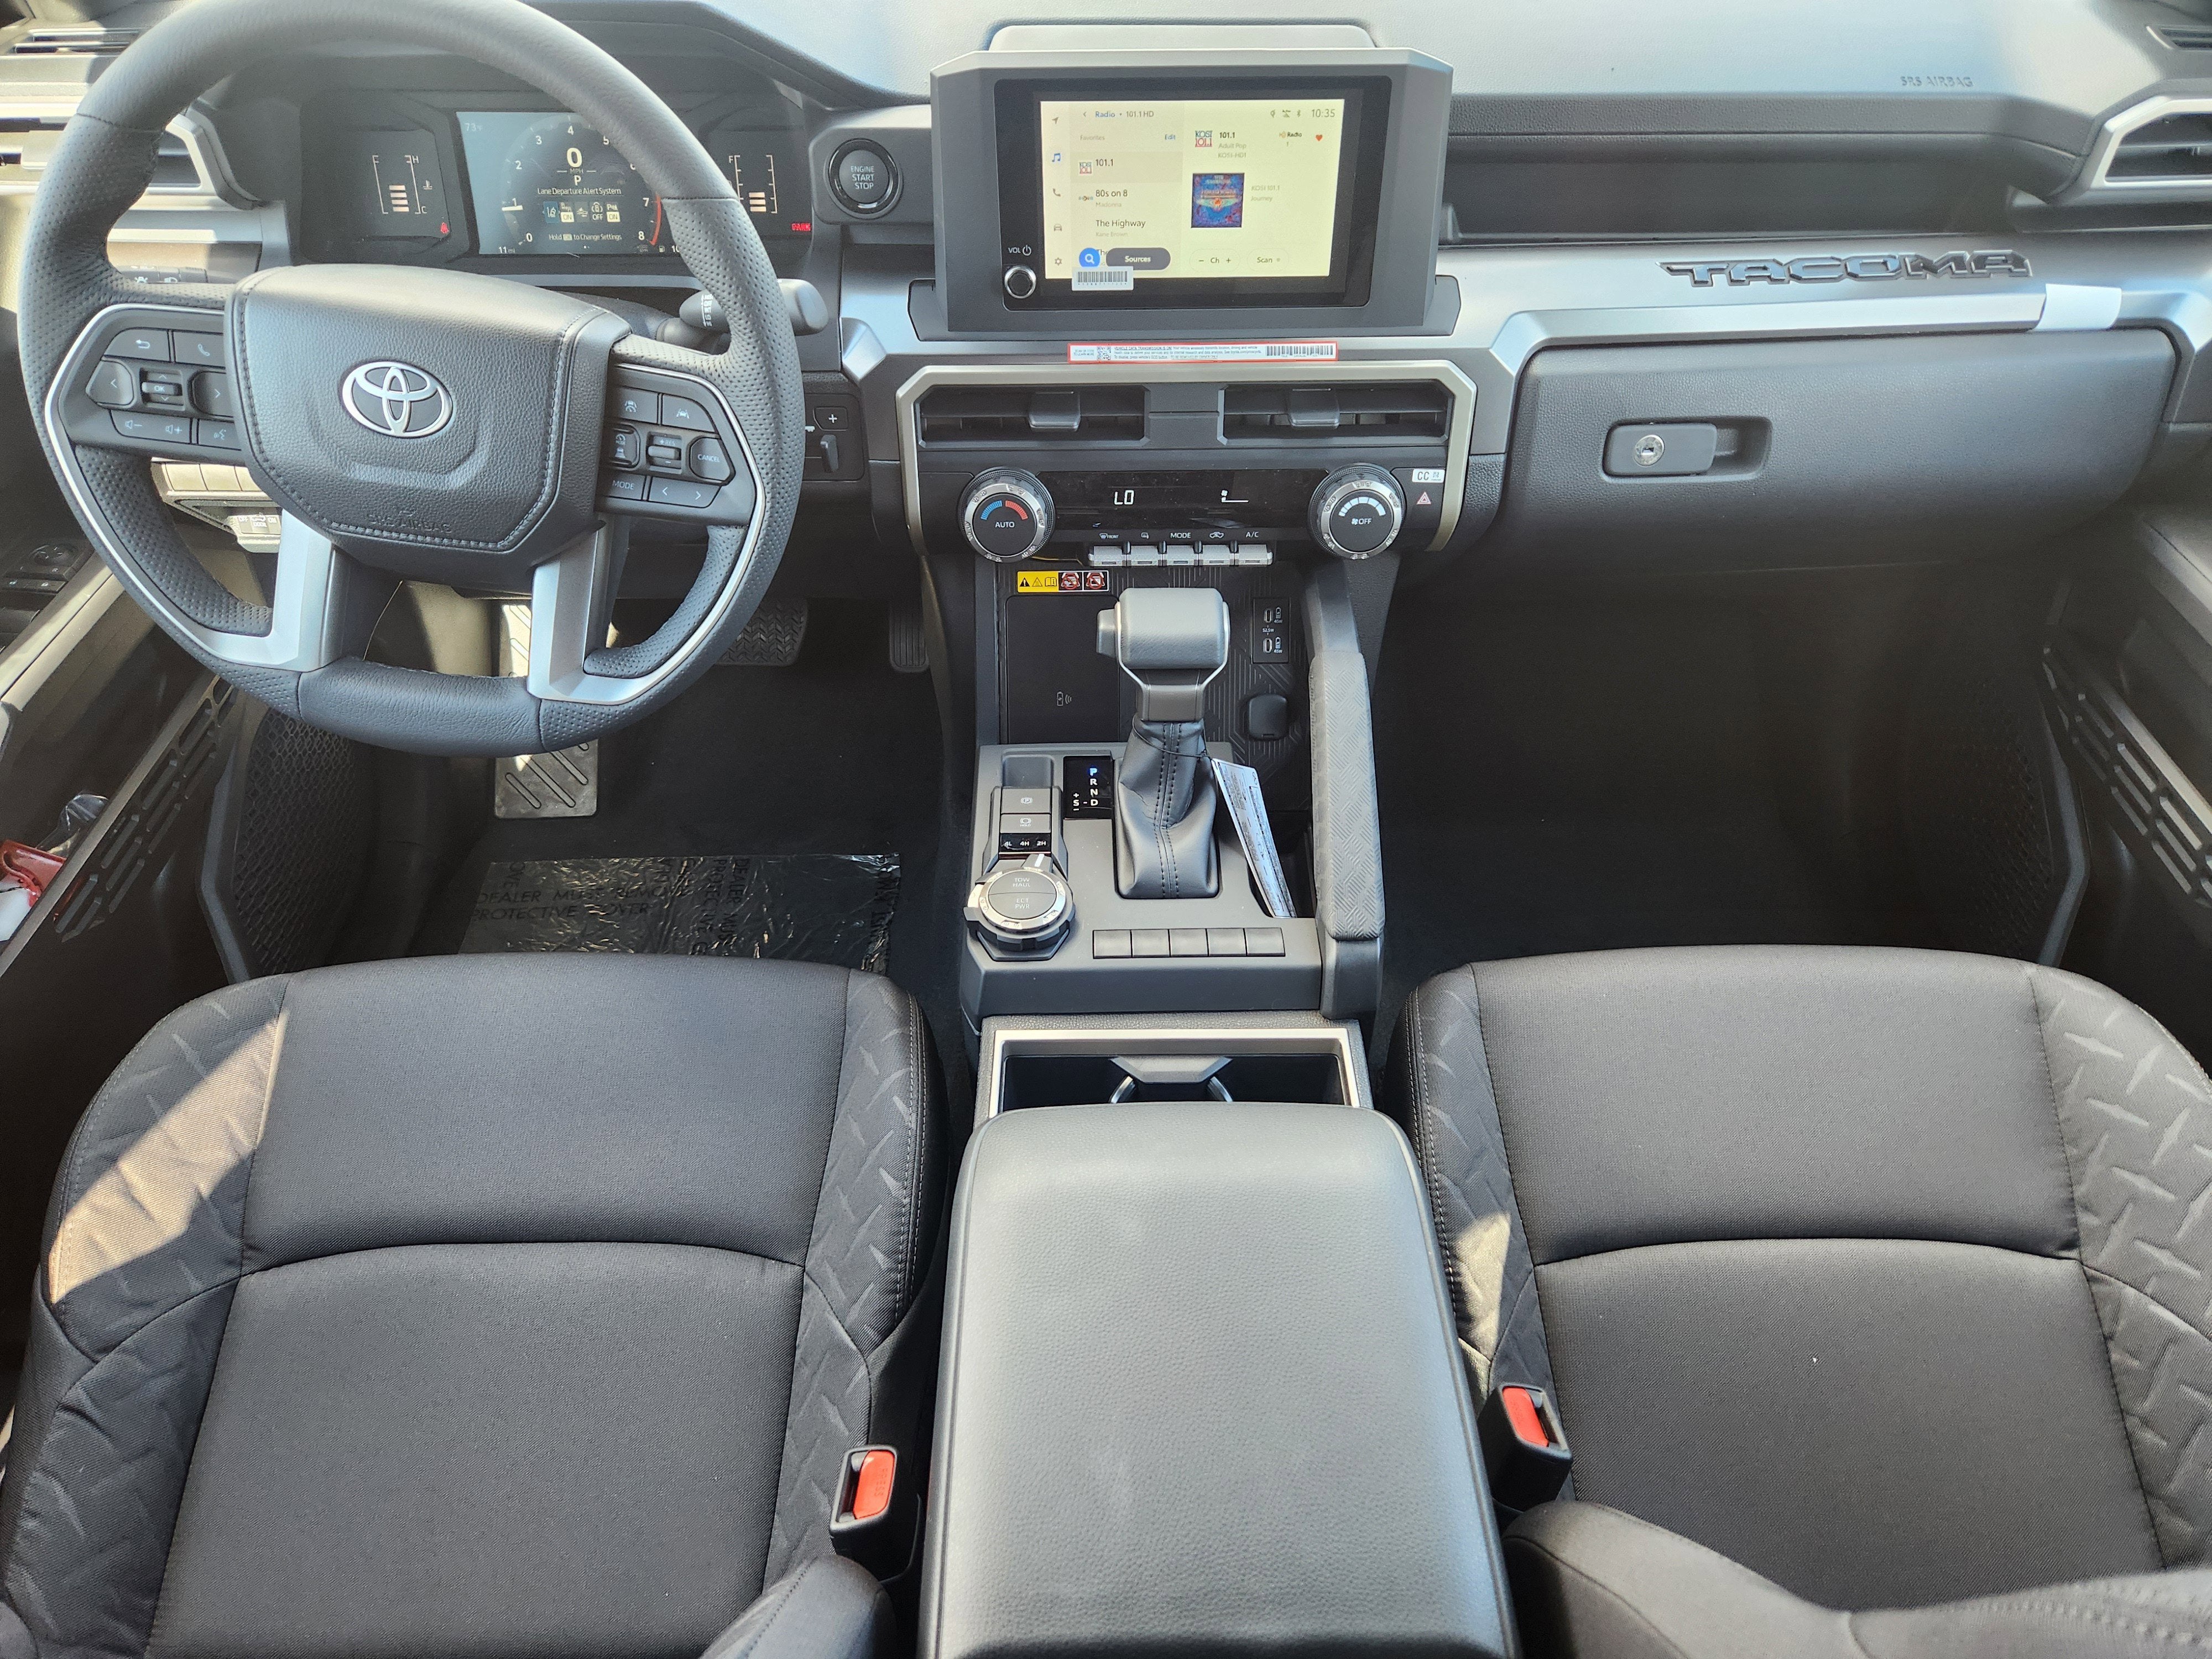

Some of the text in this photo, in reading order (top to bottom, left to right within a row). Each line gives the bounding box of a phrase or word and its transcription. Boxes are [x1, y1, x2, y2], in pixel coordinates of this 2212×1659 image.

[1901, 76, 1973, 87] SRS AIRBAG
[1311, 109, 1335, 117] 10:35
[567, 126, 574, 135] 4
[536, 135, 542, 145] 3
[567, 147, 582, 168] 0
[728, 155, 733, 164] F
[515, 160, 522, 170] 2
[575, 175, 581, 186] P
[552, 187, 583, 197] Departure
[599, 187, 621, 196] System
[1123, 189, 1128, 197] 8
[643, 197, 649, 207] 7
[1112, 220, 1146, 228] Highway
[526, 232, 533, 242] 0
[638, 231, 645, 241] 8
[1655, 250, 2033, 288] TACOMA
[697, 454, 720, 462] CANCEL
[1417, 471, 1430, 480] CC
[613, 480, 634, 490] MODE
[1114, 489, 1135, 505] LO
[1089, 768, 1098, 776] P
